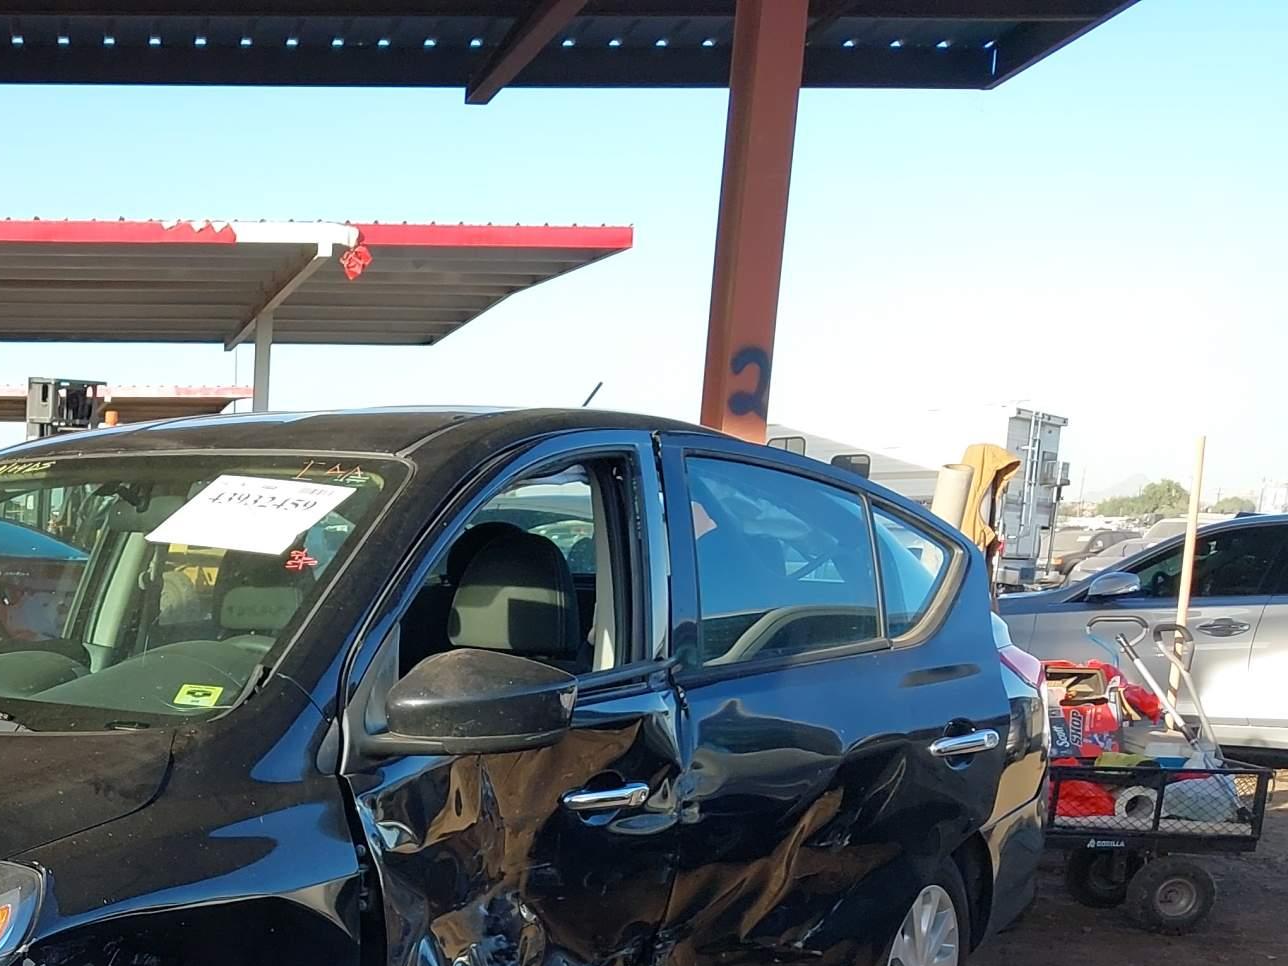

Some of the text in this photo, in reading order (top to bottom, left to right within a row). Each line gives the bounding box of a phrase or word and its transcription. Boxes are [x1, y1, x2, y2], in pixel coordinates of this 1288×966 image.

[729, 345, 770, 418] 2
[1053, 725, 1070, 748] Scott
[1070, 710, 1083, 746] SHOP
